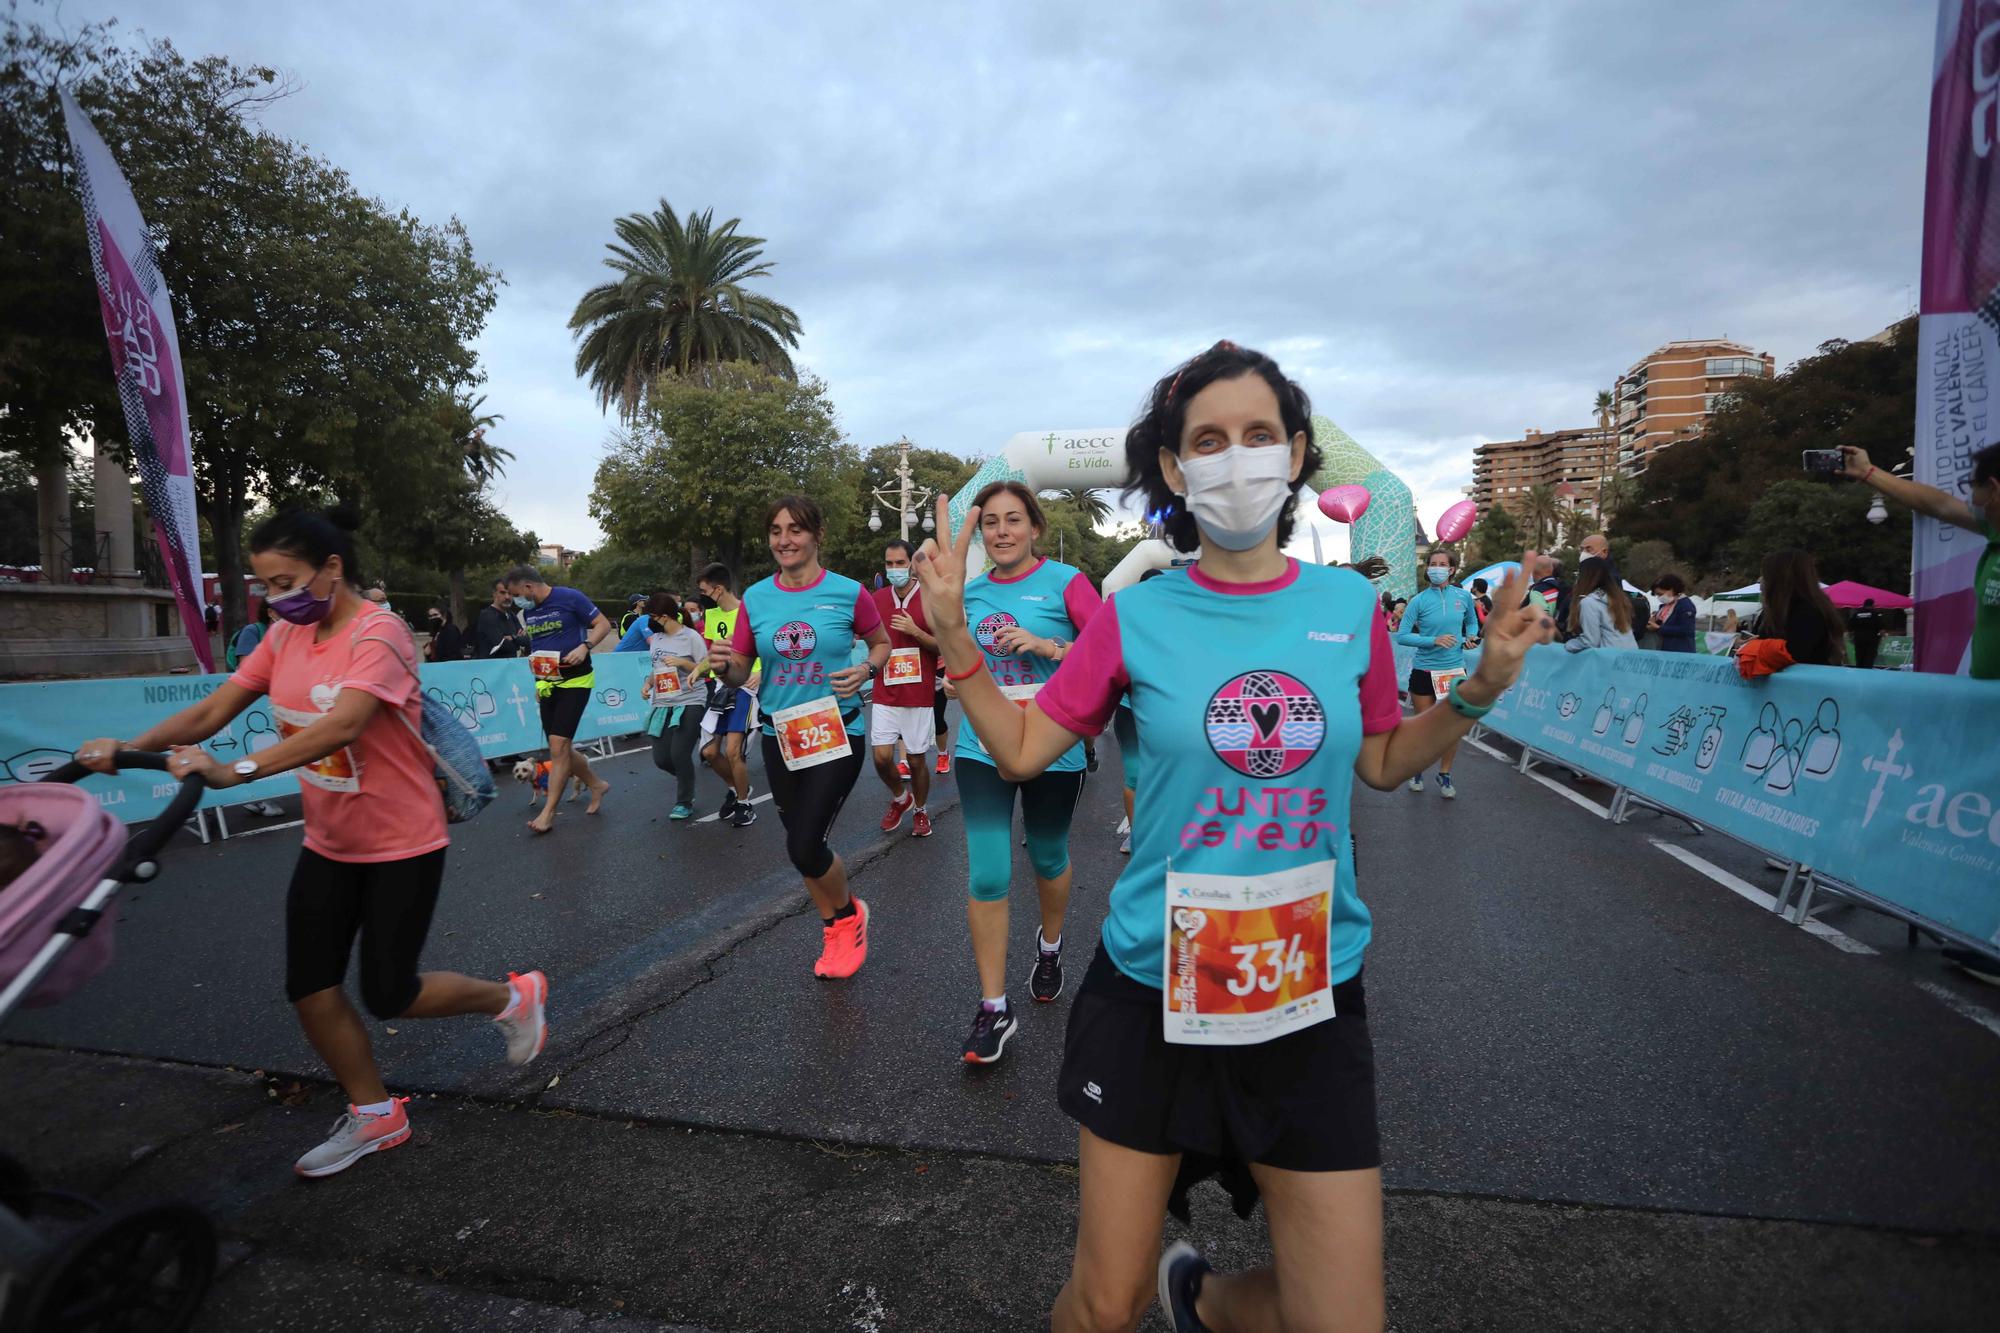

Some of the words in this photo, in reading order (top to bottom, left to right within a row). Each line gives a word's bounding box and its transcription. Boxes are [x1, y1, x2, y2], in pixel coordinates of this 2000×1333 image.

[1934, 332, 1951, 450] PROVINCIAL
[1064, 436, 1115, 450] aecc
[1069, 457, 1081, 469] Es
[540, 663, 552, 673] 73
[893, 661, 913, 674] 365
[144, 682, 212, 704] NORMAS
[798, 723, 832, 750] 325
[1905, 783, 2000, 849] ae
[1226, 933, 1307, 997] 334
